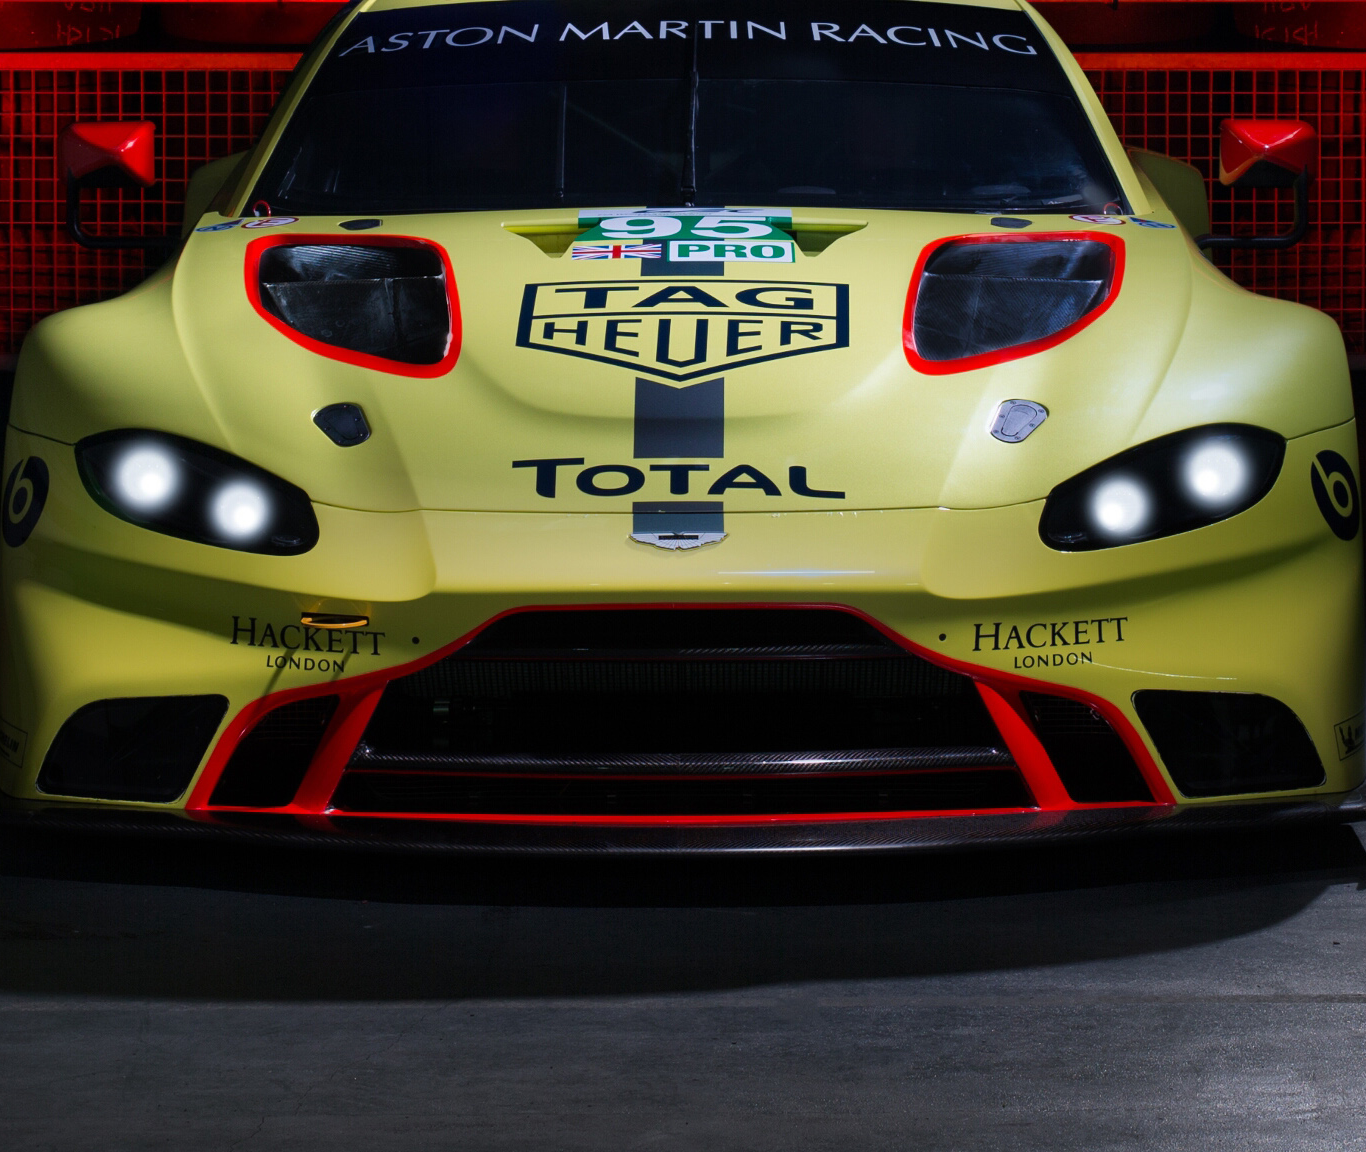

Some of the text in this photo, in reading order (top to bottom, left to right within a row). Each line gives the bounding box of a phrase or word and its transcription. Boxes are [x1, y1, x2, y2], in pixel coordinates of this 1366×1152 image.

[337, 19, 1039, 58] ASTON MARTIN RACING
[599, 215, 773, 239] 95
[676, 243, 785, 259] PRO
[554, 285, 815, 311] TAG
[542, 318, 824, 369] HEUER
[511, 456, 847, 500] TOTAL
[229, 615, 386, 656] HACKETT
[971, 616, 1129, 652] HACKETT
[266, 654, 346, 673] LONDON
[1013, 650, 1094, 670] LONDON
